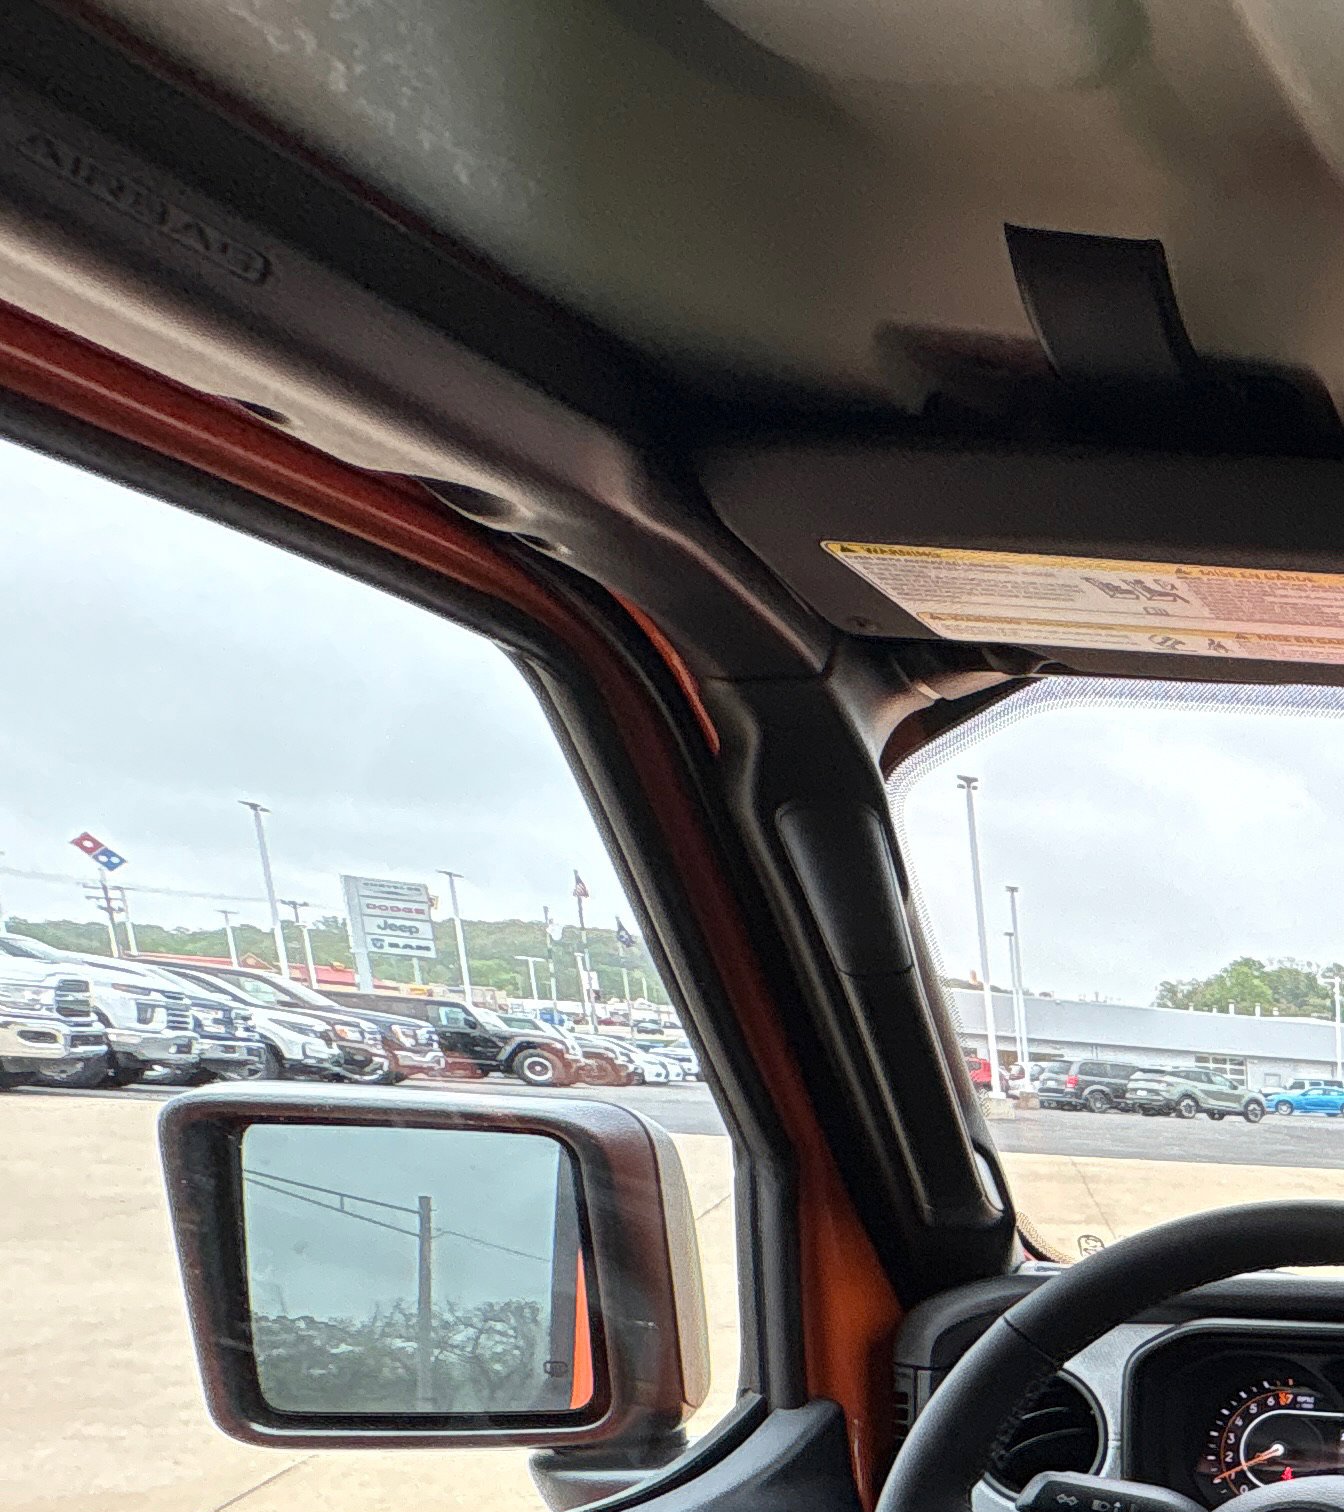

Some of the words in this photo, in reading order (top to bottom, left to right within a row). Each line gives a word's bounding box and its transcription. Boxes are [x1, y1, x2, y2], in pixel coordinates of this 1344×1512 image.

[366, 903, 426, 915] DODGE
[376, 919, 420, 935] Jeep
[387, 942, 432, 952] RAM
[1267, 1396, 1275, 1406] 6
[1250, 1403, 1258, 1414] 5
[1235, 1416, 1244, 1426] 4
[1227, 1433, 1235, 1444] 3
[1225, 1451, 1233, 1463] 2
